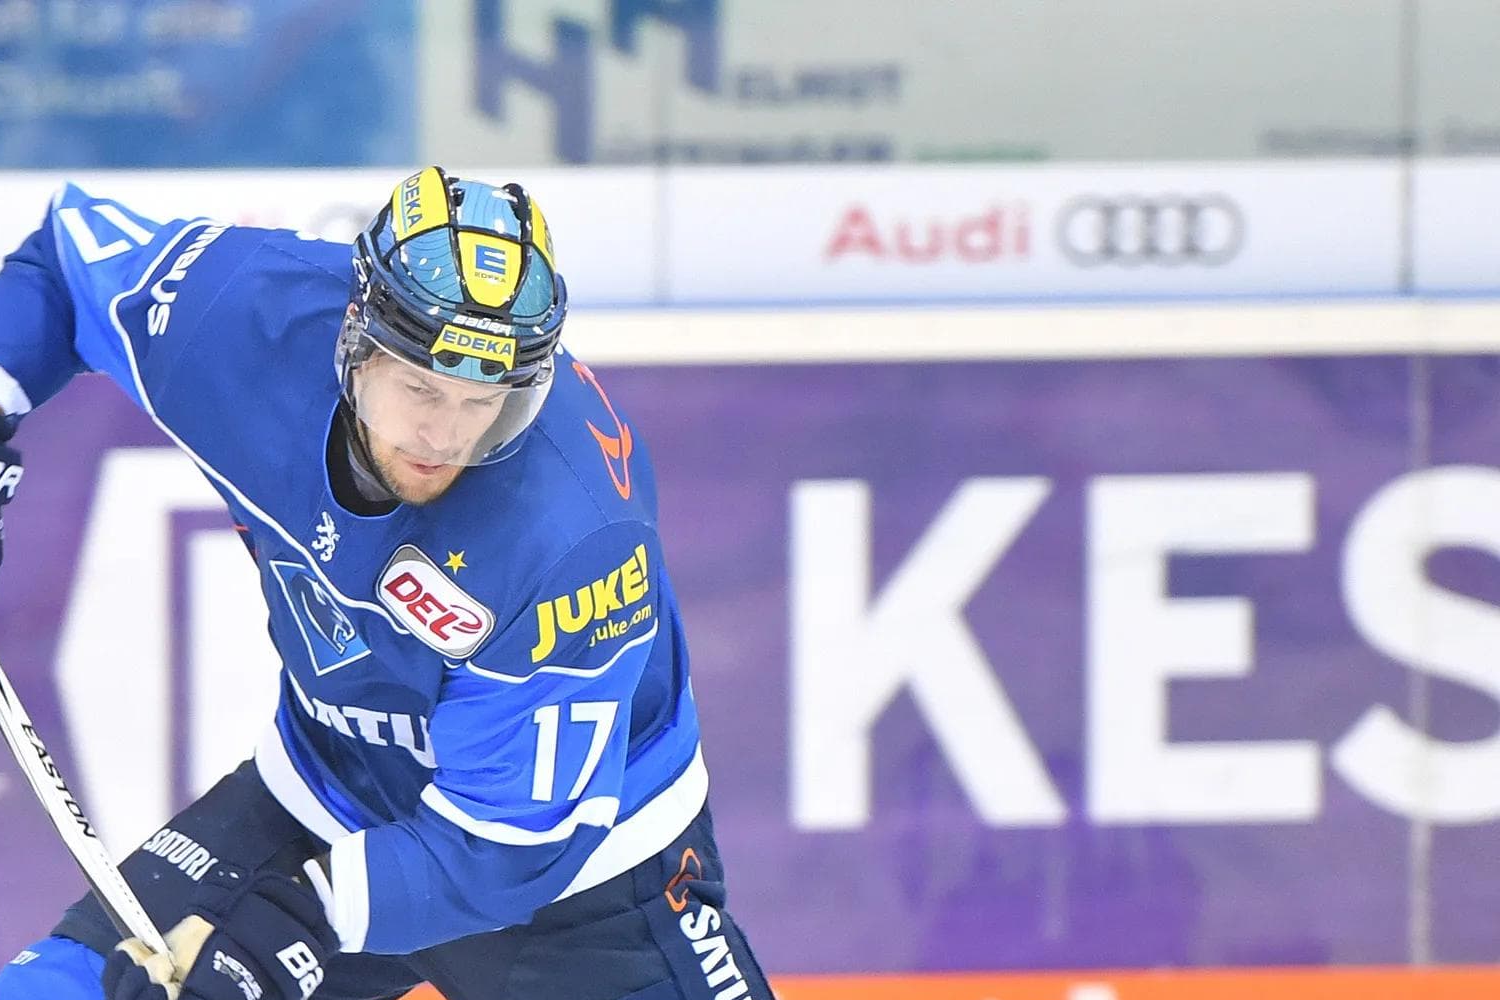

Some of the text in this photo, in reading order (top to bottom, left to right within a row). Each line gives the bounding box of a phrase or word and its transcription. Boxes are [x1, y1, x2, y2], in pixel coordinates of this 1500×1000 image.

[824, 203, 1031, 266] Audi
[442, 329, 513, 356] EDEKA
[384, 570, 473, 643] DEL
[531, 543, 650, 664] JUKE!
[789, 463, 1500, 831] KES
[21, 722, 97, 839] EASTON
[531, 700, 620, 802] 17
